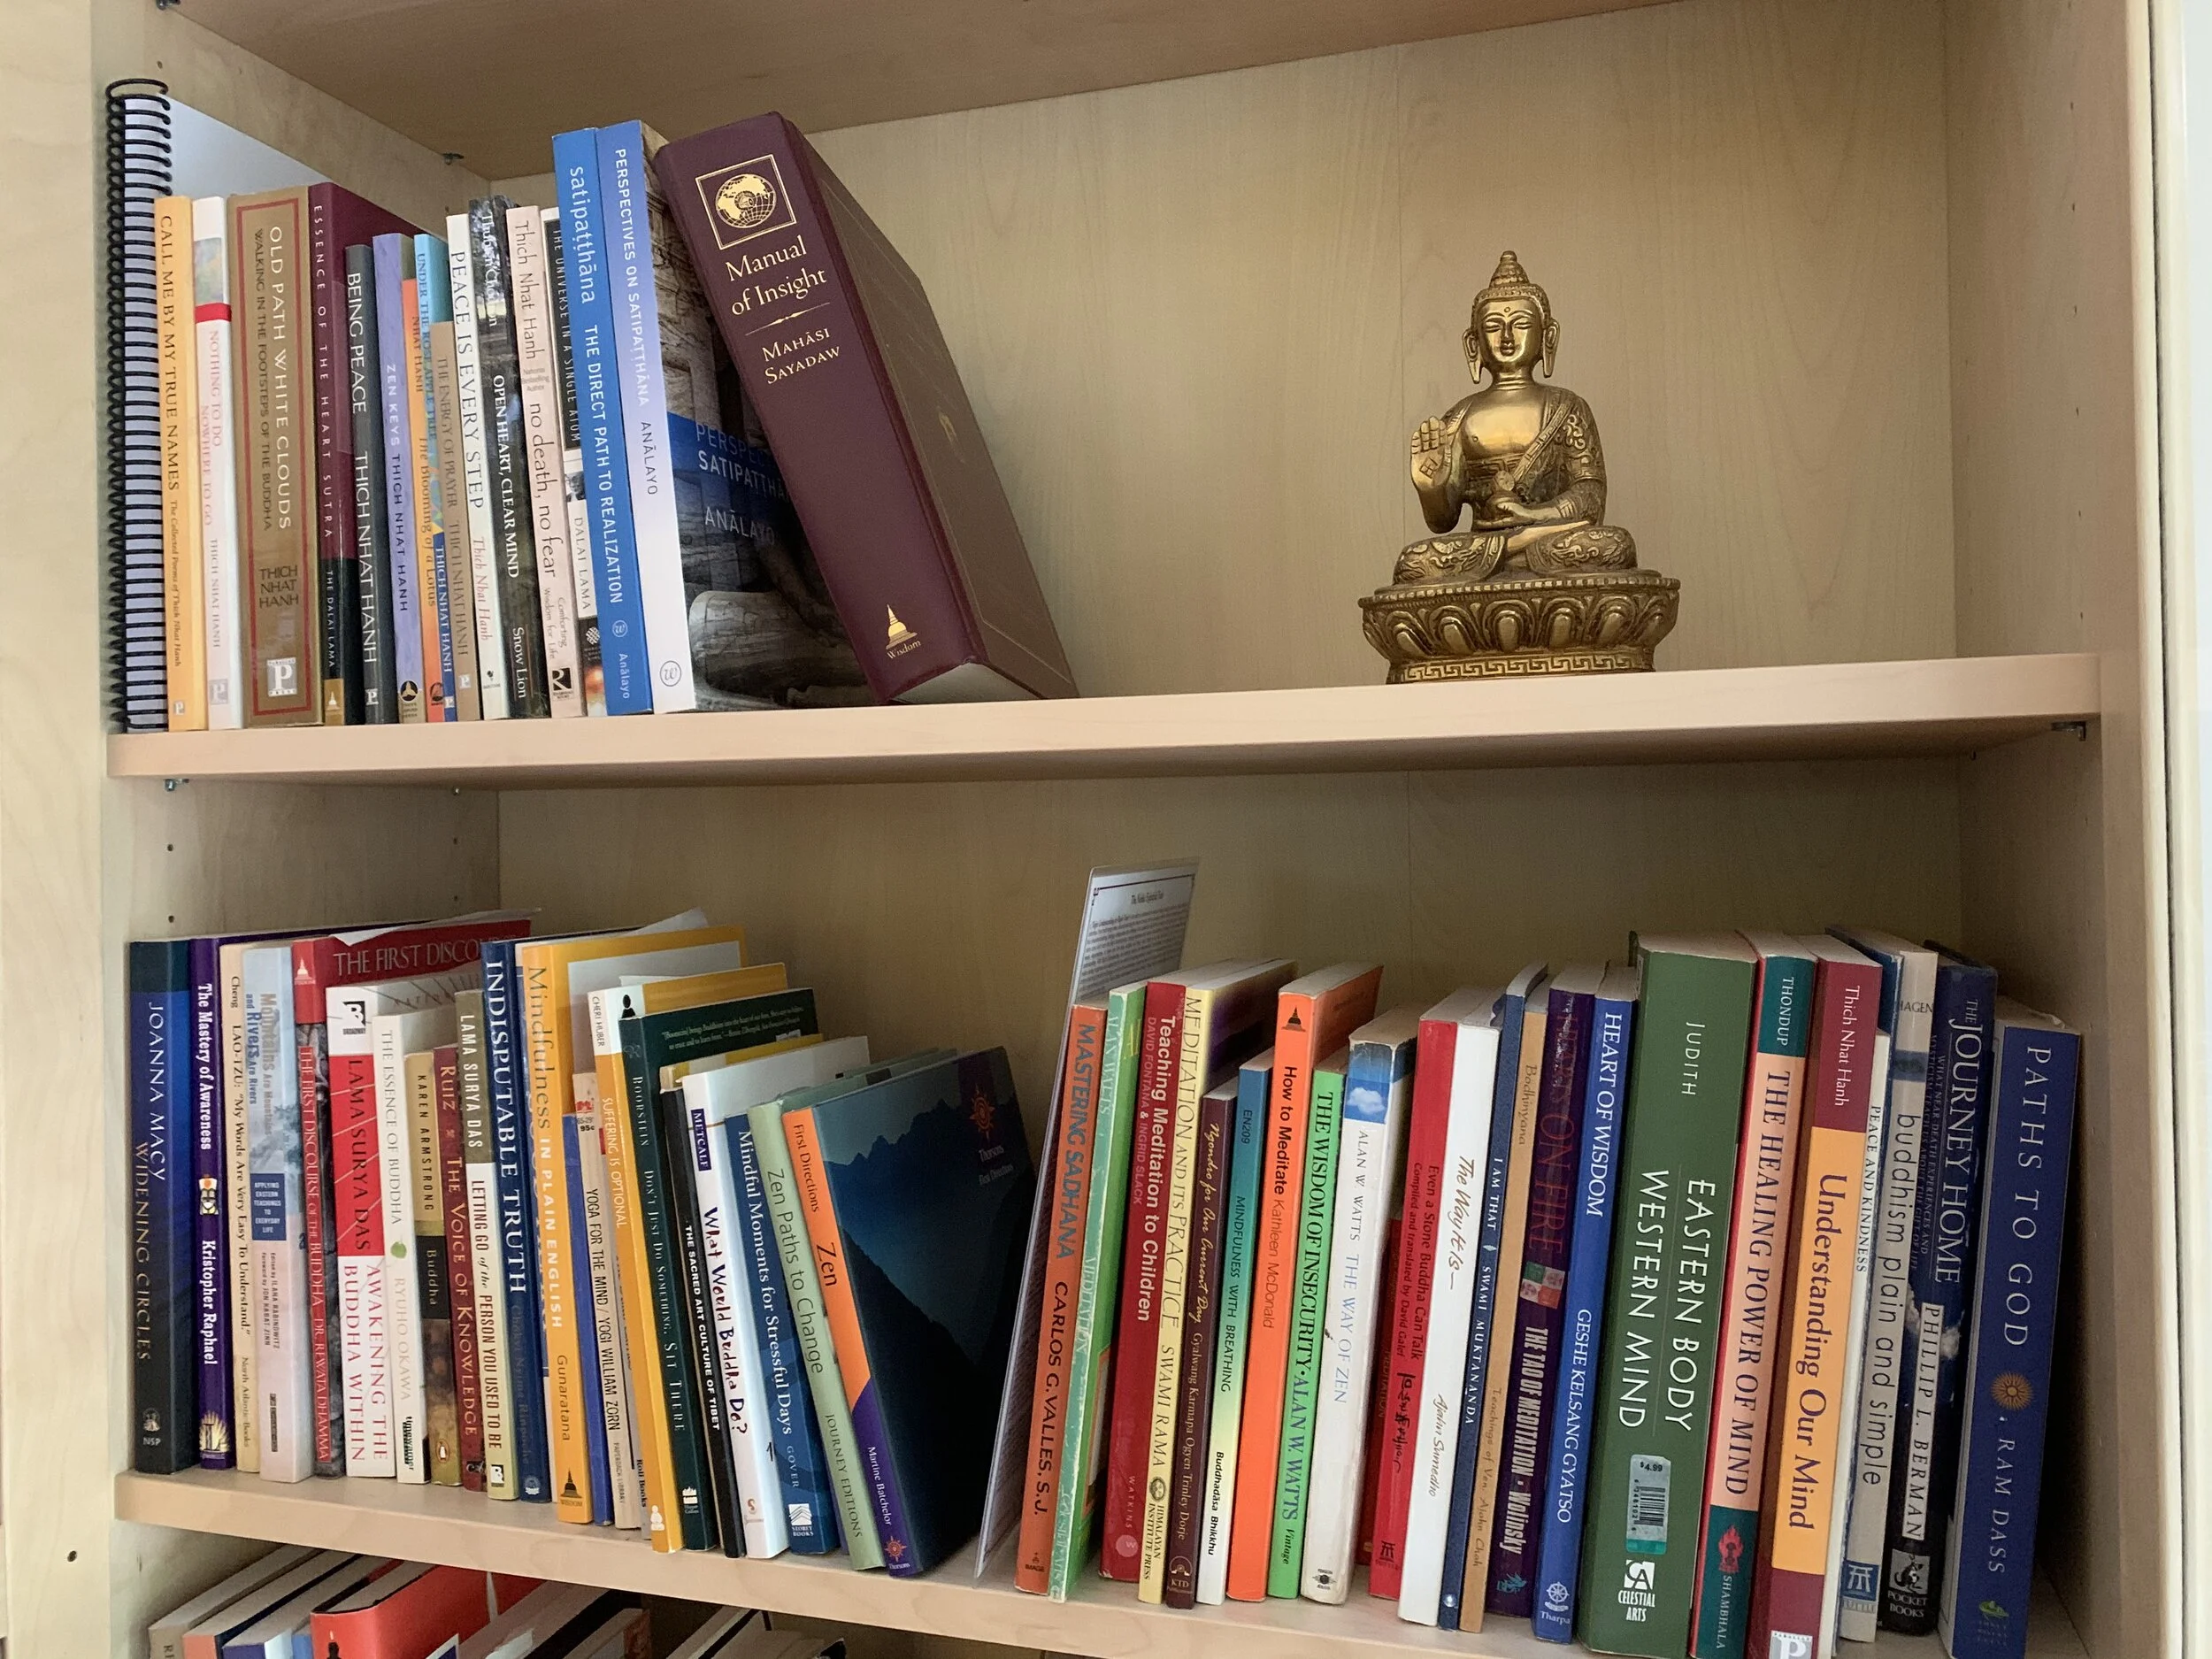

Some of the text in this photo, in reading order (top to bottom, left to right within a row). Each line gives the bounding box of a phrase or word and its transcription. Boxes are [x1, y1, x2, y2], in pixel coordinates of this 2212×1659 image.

[514, 220, 536, 264] Thich
[518, 273, 540, 309] Nhat
[616, 149, 650, 408] PERSPECTIVES ON SATIPAṬṬHĀNA
[726, 234, 807, 281] Manual
[732, 266, 826, 316] of Insight
[160, 215, 179, 490] CALL ME BY MY TRUE NAMES
[269, 227, 291, 528] OLD PATH WHITE CLOUDS
[348, 273, 366, 413] BEING PEACE
[450, 250, 483, 508] PEACE IS EVERY STEP
[521, 319, 544, 359] Hanh
[764, 345, 840, 386] SAYADAW
[493, 374, 519, 578] OPEN HEART, CLEAR MIND
[529, 403, 541, 428] no
[532, 435, 557, 497] death,
[584, 326, 623, 603] THE DIRECT PATH TO REALIZATION
[641, 421, 658, 495] ANĀLAYO
[354, 451, 377, 662] THICH NHAT HANH
[539, 504, 550, 530] no
[541, 535, 563, 578] fear
[512, 627, 526, 698] Snow Lion
[887, 639, 921, 661] Wisdom
[196, 983, 214, 1150] The Mastery of Awareness
[1681, 1022, 1706, 1095] JUDITH
[1777, 977, 1794, 1047] THONDUP
[149, 1002, 165, 1180] JOANNA MACY
[460, 1015, 482, 1148] LAMA SURYA DAS
[486, 961, 517, 1178] INDISPUTABLE
[502, 1188, 526, 1293] TRUTH
[695, 1113, 707, 1167] METCALF
[1056, 1023, 1096, 1259] MASTERING SADHANA
[1274, 1065, 1298, 1194] How to Meditate
[1586, 1012, 1622, 1217] HEART OF WISDOM
[794, 1124, 820, 1212] First Directions
[1138, 1015, 1176, 1322] Teaching Meditation to Children
[1356, 1131, 1369, 1168] ALAN
[1935, 1019, 1983, 1284] JOURNEY HOME
[2003, 1048, 2052, 1346] PATHS TO GOD
[739, 1130, 792, 1435] Mindful Moments for Stressful Days
[767, 1168, 823, 1374] Zen Paths to Change
[816, 1242, 838, 1286] Zen
[1349, 1195, 1364, 1241] WATTS
[1725, 1071, 1791, 1494] THE HEALING POWER OF MIND
[200, 1240, 217, 1364] Kristopher Raphael
[685, 1225, 720, 1430] THE SACRED ART CULTURE OF TIBET
[703, 1207, 748, 1434] What Would Buddha Do?
[1333, 1255, 1360, 1403] THE WAY OF ZEN
[1619, 1170, 1670, 1427] WESTERN MIND
[1665, 1179, 1717, 1432] EASTERN BODY
[1789, 1174, 1847, 1530] Understanding Our Mind
[1861, 1113, 1921, 1486] buddhism plain and simple
[1033, 1281, 1069, 1516] CARLOS G. VALLES, S.J.
[1511, 1326, 1548, 1477] THE TAO OF MEDITATION
[1906, 1307, 1940, 1539] PHILLIP L. BERMAN
[867, 1446, 892, 1525] Martine Batchelor
[1499, 1490, 1531, 1555] Wolinsky
[1640, 1462, 1663, 1472] $4.99
[1988, 1437, 2016, 1574] RAM DASS
[1208, 1515, 1219, 1555] Bhikkhu
[1617, 1590, 1655, 1608] CELESTIAL
[1888, 1592, 1927, 1606] POCKET
[1540, 1609, 1571, 1624] Tharpa
[1626, 1608, 1647, 1622] ARTS
[1889, 1605, 1924, 1617] BOOKS
